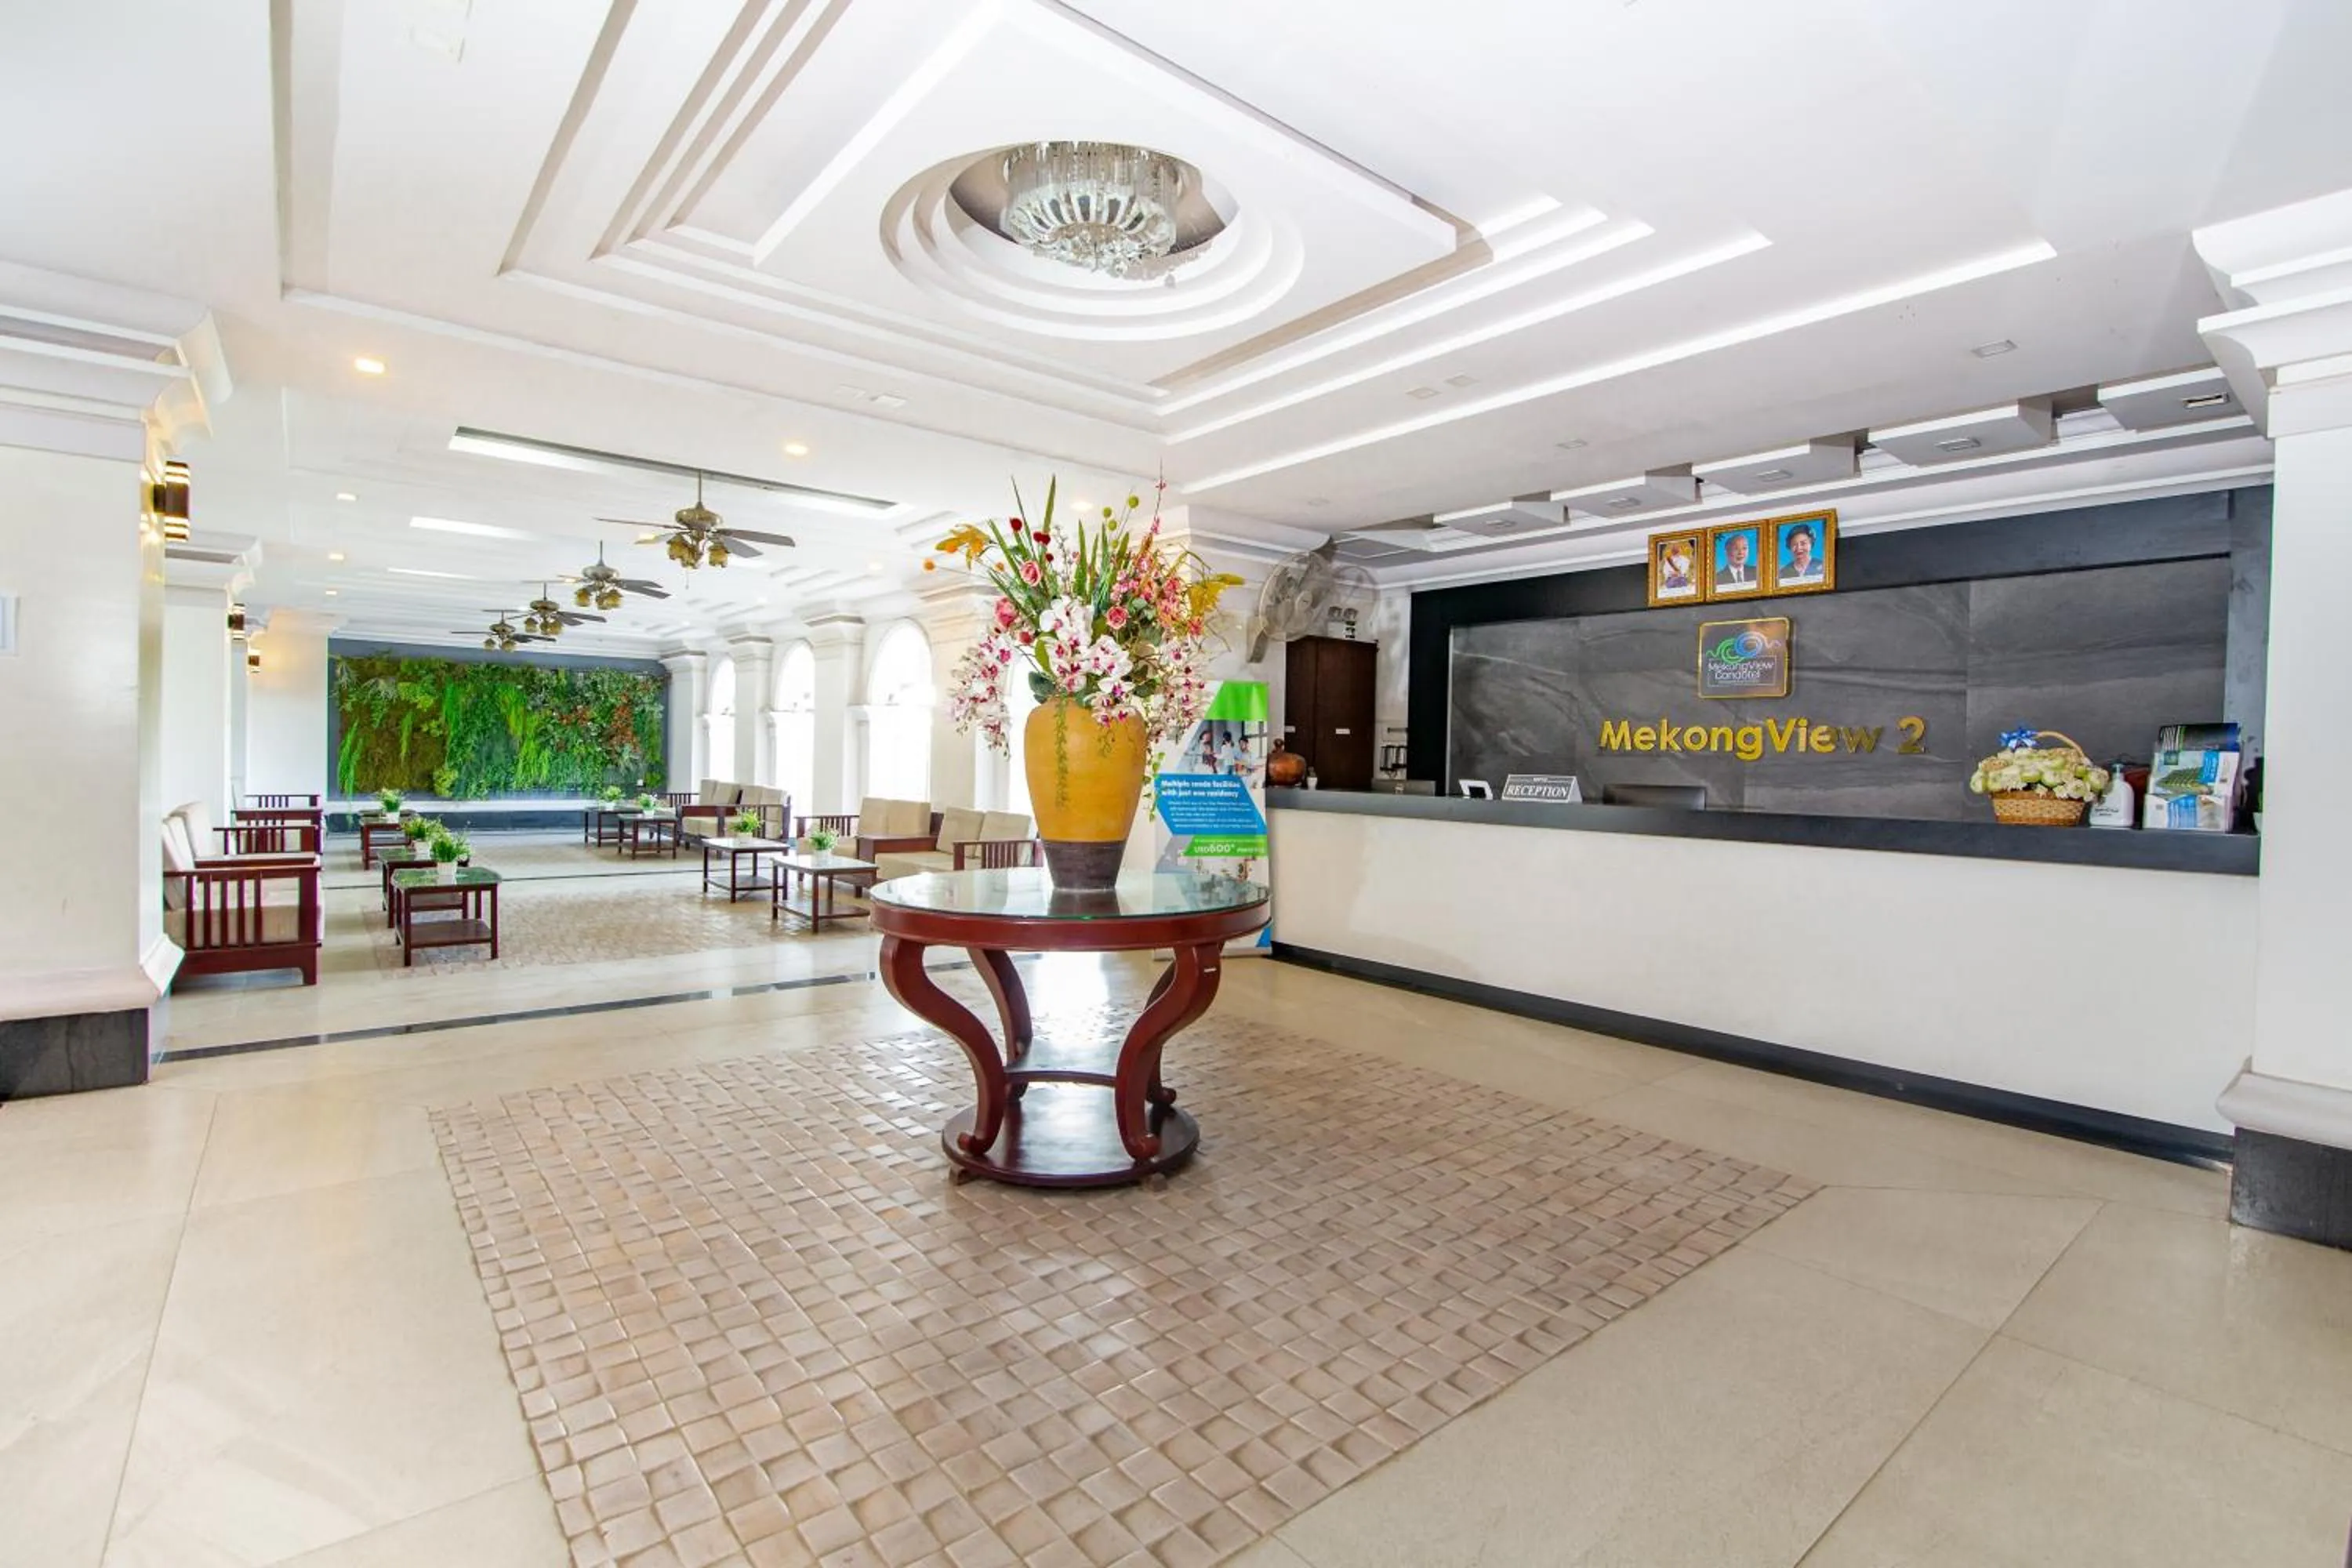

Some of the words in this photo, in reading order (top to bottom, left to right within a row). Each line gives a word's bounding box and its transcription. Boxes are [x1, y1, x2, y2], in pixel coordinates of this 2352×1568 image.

[1599, 716, 1884, 762] MekongView
[1896, 715, 1927, 755] 2
[1178, 789, 1191, 798] just
[1506, 785, 1568, 797] RECEPTION
